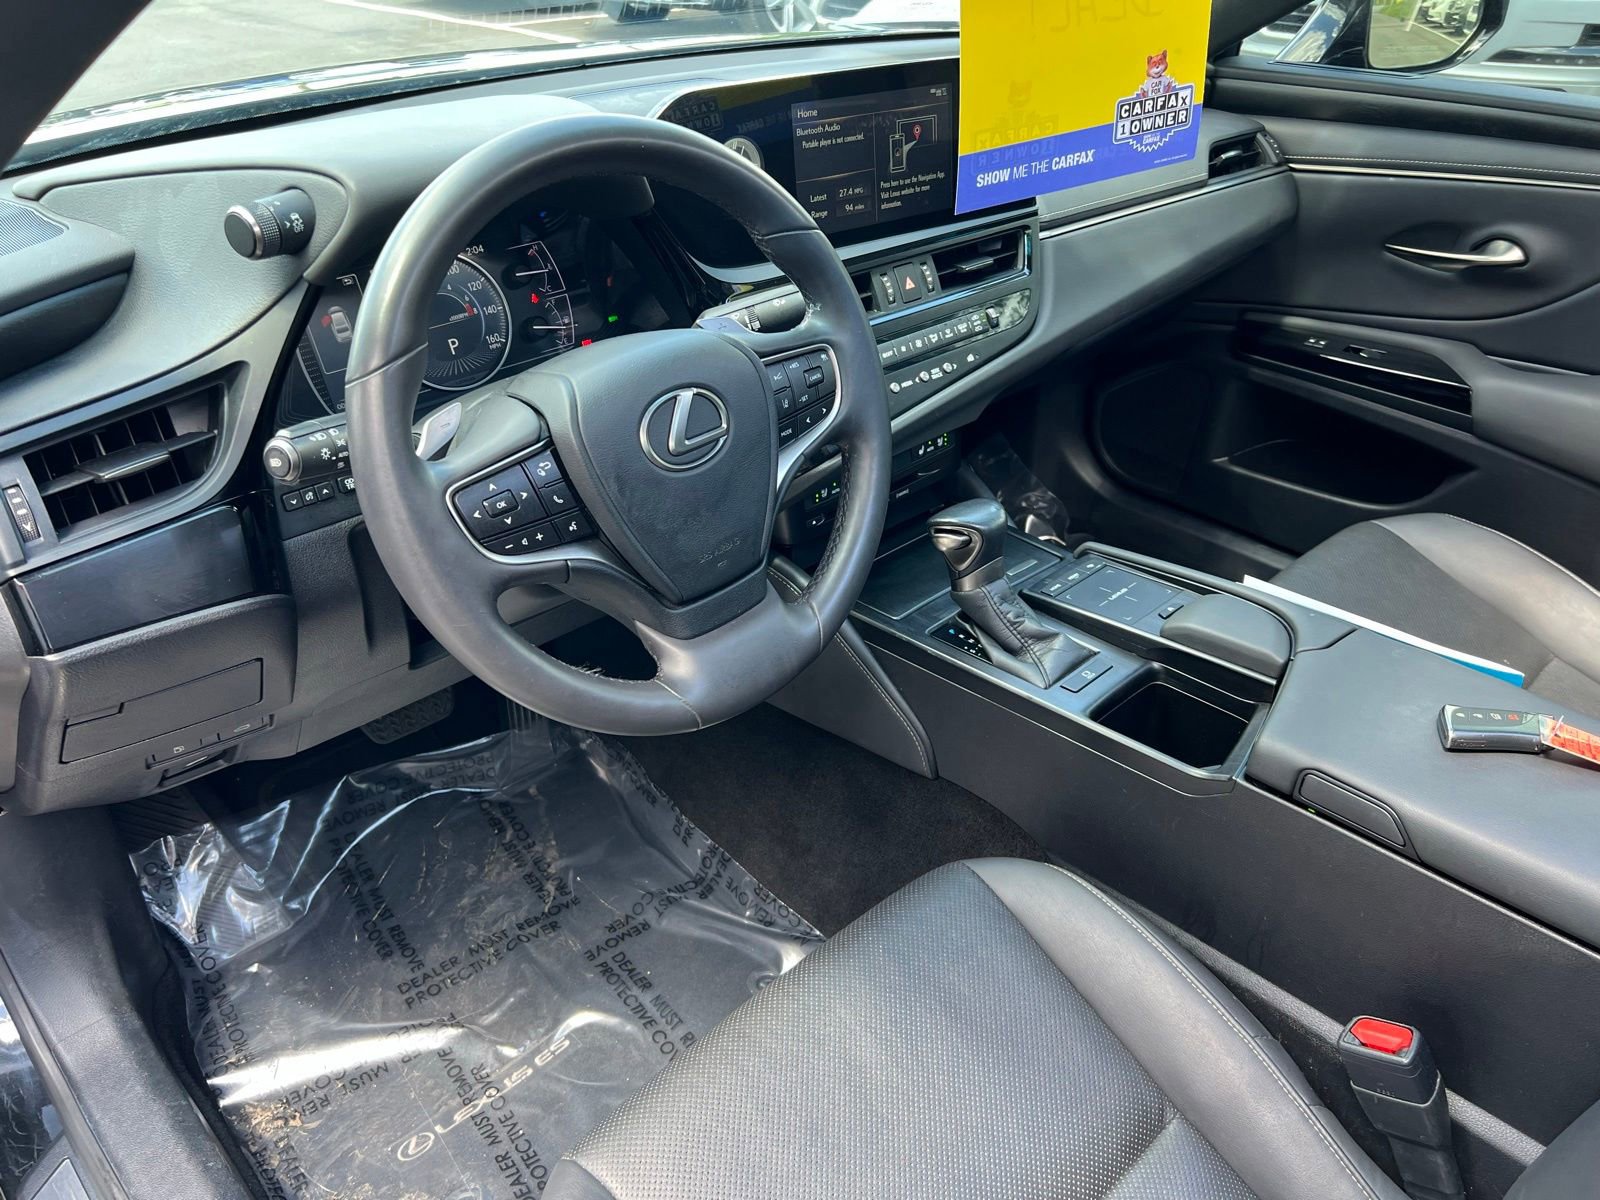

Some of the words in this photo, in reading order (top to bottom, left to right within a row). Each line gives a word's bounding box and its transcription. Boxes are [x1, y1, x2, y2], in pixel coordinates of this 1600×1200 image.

[797, 108, 818, 118] Home
[1120, 93, 1189, 118] CARFAX
[796, 126, 824, 136] Bluetooth
[824, 123, 841, 132] Audio
[802, 140, 819, 149] Portable
[820, 138, 832, 148] player
[976, 168, 1010, 188] SHOW
[1012, 163, 1029, 180] ME
[1030, 159, 1050, 175] THE
[1051, 149, 1095, 171] CARFAX
[880, 180, 891, 188] Press
[891, 180, 900, 188] here
[918, 172, 938, 182] Navigation
[810, 194, 827, 202] Latest
[839, 187, 853, 198] 27.4
[880, 190, 890, 199] Visit
[901, 187, 915, 195] website
[921, 184, 930, 192] more
[811, 210, 828, 220] Range
[844, 204, 854, 212] 94
[466, 244, 484, 256] 2:04
[468, 281, 482, 293] 120
[464, 294, 470, 302] 6
[483, 304, 498, 316] 140
[448, 338, 460, 356] P
[486, 333, 500, 344] 160
[780, 428, 793, 438] MODE
[496, 500, 507, 509] OK
[696, 851, 732, 900] DEALER
[343, 831, 375, 885] DEALER
[368, 887, 395, 922] MUST
[387, 923, 425, 974] REMOVE
[725, 876, 776, 928] REMOVE
[604, 891, 655, 934] COVER
[362, 919, 394, 961] COVER
[397, 956, 460, 995] DEALER
[467, 928, 511, 957] MUST
[515, 896, 581, 932] REMOVE
[583, 919, 652, 962] REMOVE
[403, 949, 504, 1010] PROTECTIVE
[505, 920, 562, 952] COVER
[594, 961, 658, 1030] PROTECTIVE
[611, 951, 653, 993] DEALER
[648, 994, 684, 1031] MUST
[534, 1036, 571, 1066] ES
[437, 1046, 478, 1107] REMOVE
[470, 1063, 506, 1111] COVER
[470, 1110, 503, 1147] MUST
